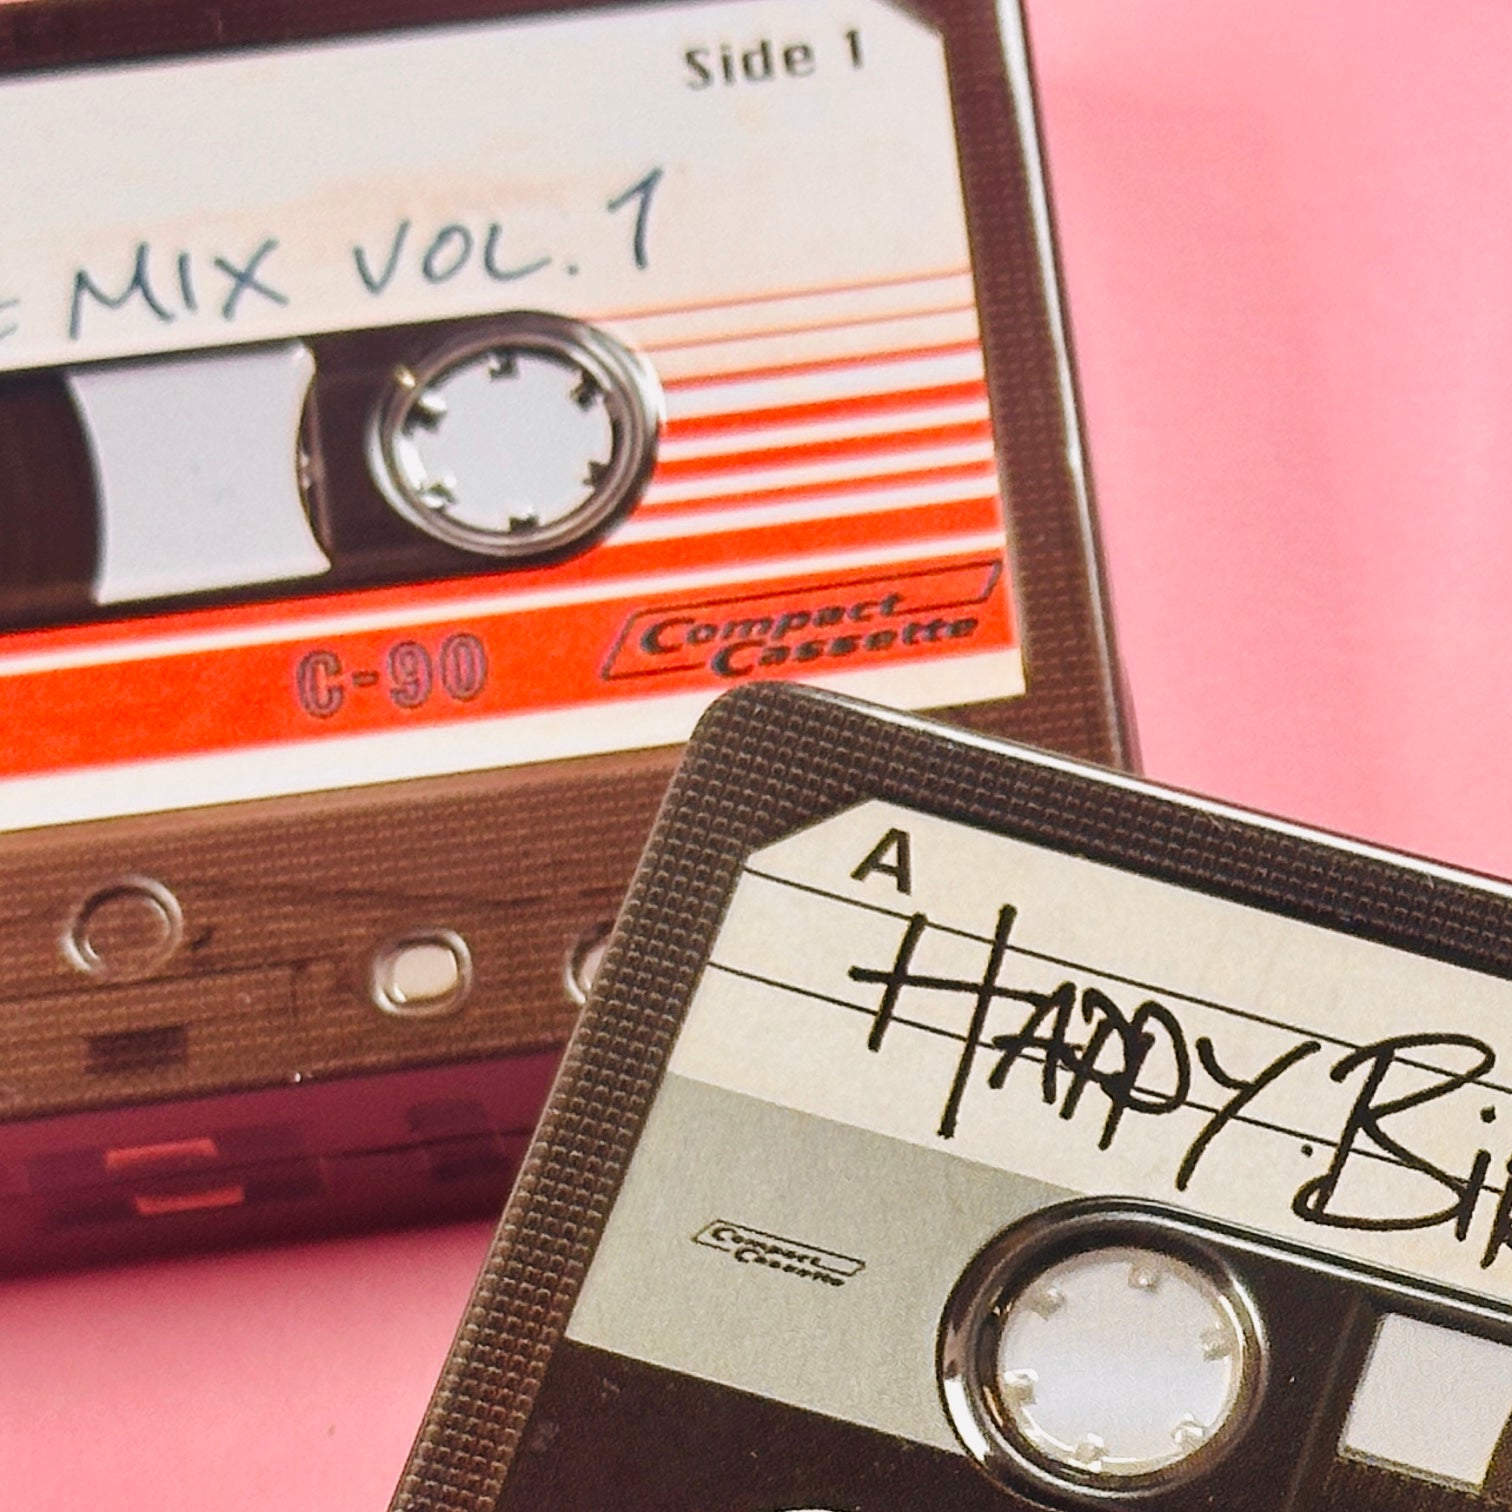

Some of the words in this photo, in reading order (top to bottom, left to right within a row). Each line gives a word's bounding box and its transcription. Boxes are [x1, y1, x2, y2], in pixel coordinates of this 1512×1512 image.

[685, 38, 815, 90] Side
[843, 33, 864, 69] 1
[69, 241, 289, 340] MIX
[353, 220, 578, 296] VOL.
[607, 166, 664, 271] 1
[640, 594, 902, 656] Compact
[711, 615, 980, 677] Cassette
[295, 632, 489, 719] C-90
[851, 827, 912, 894] A
